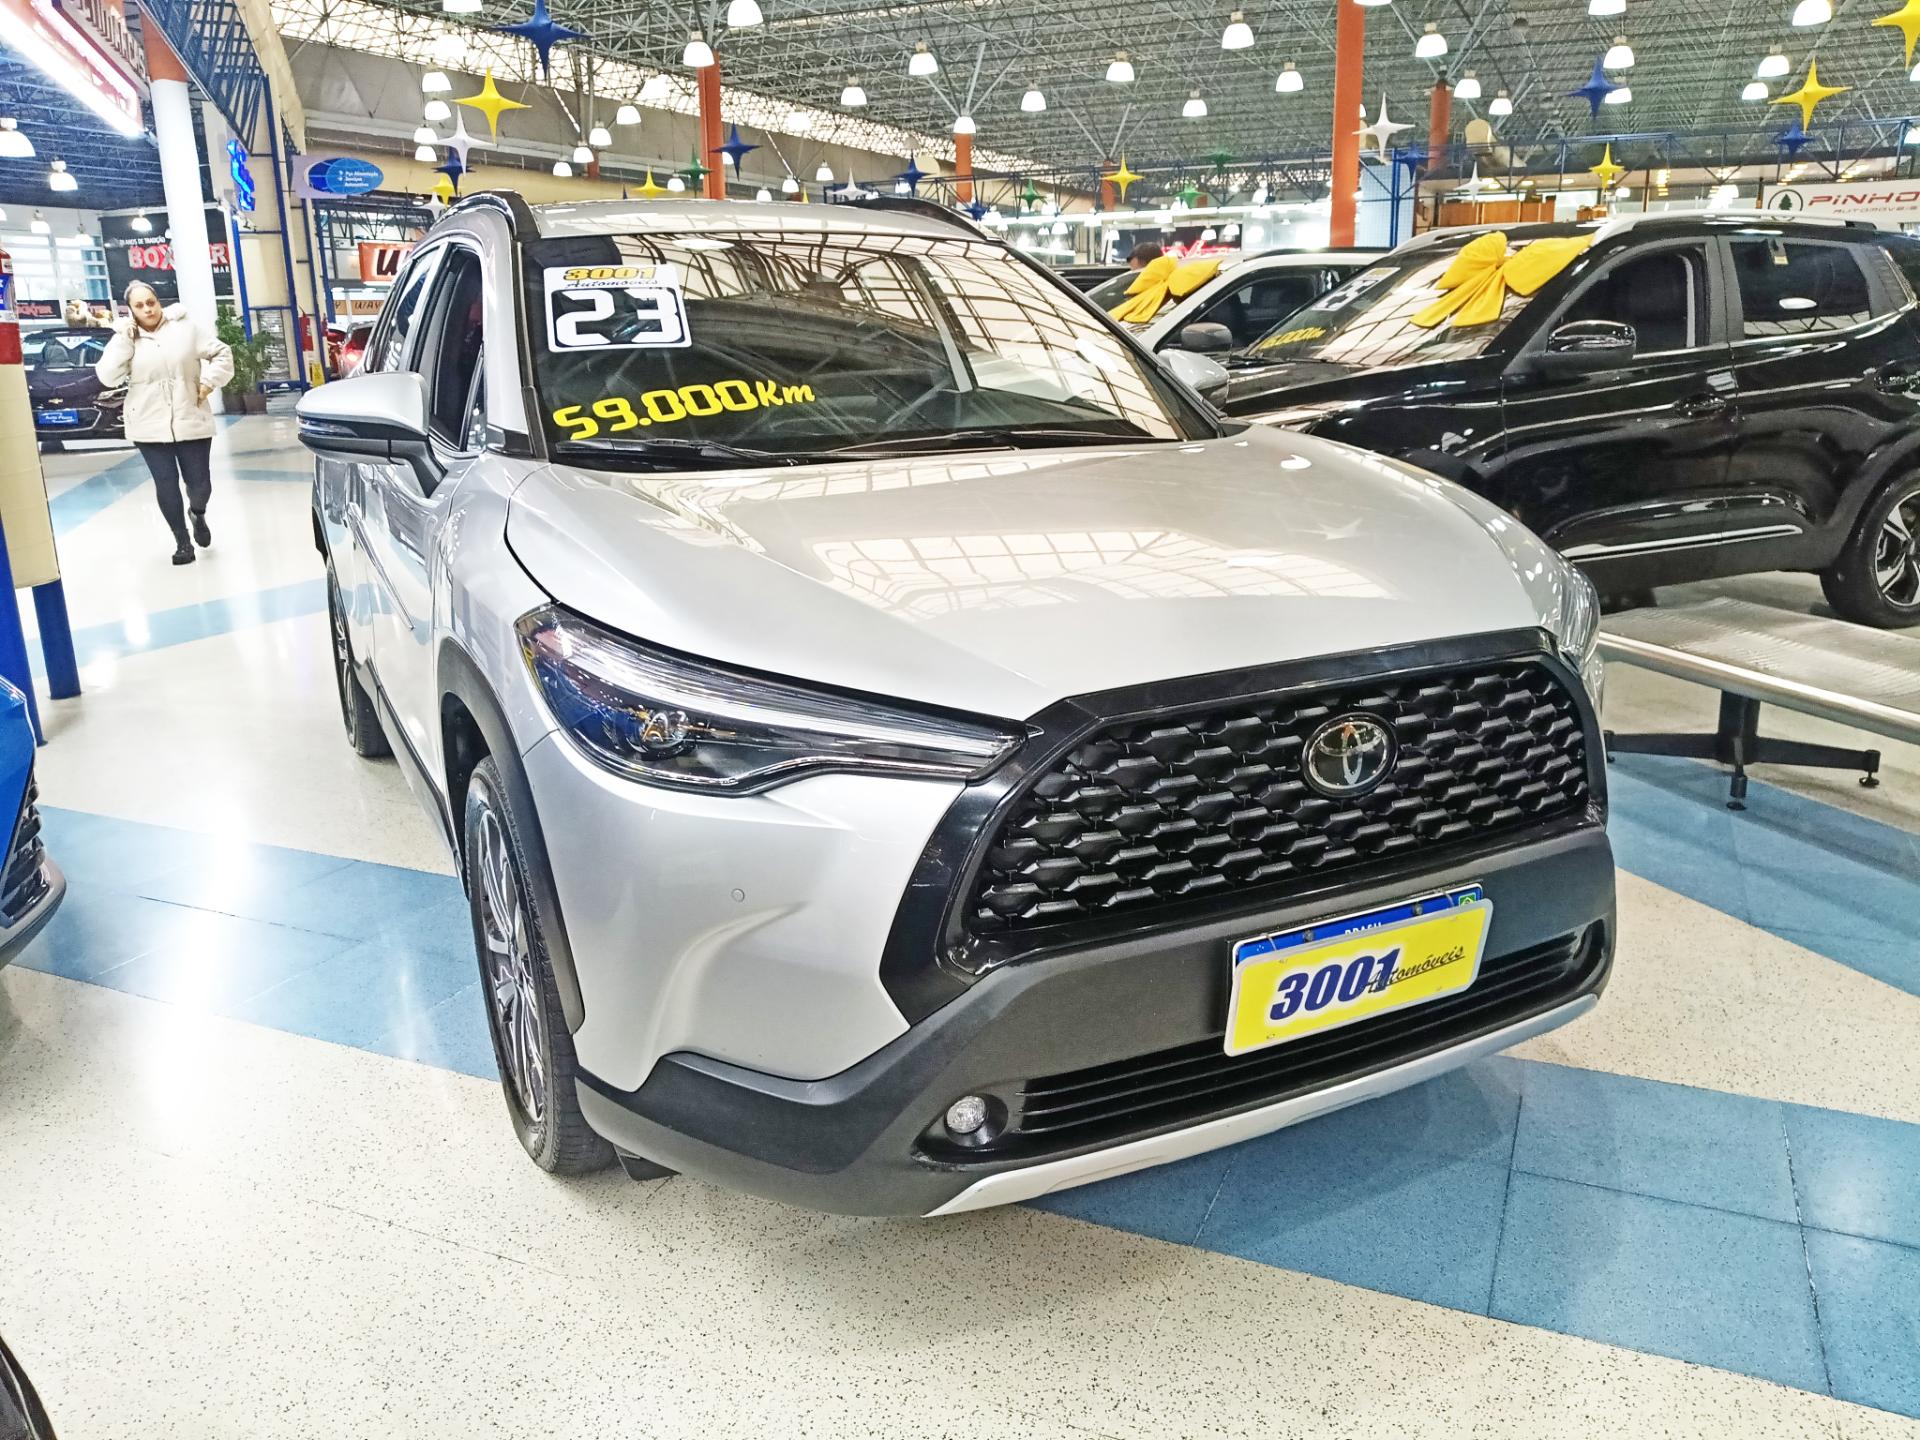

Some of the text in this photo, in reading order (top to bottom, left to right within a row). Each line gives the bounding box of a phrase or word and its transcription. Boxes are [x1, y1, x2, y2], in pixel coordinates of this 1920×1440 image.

[563, 267, 656, 280] 3001
[556, 287, 682, 346] 23
[1269, 948, 1400, 1020] 3001
